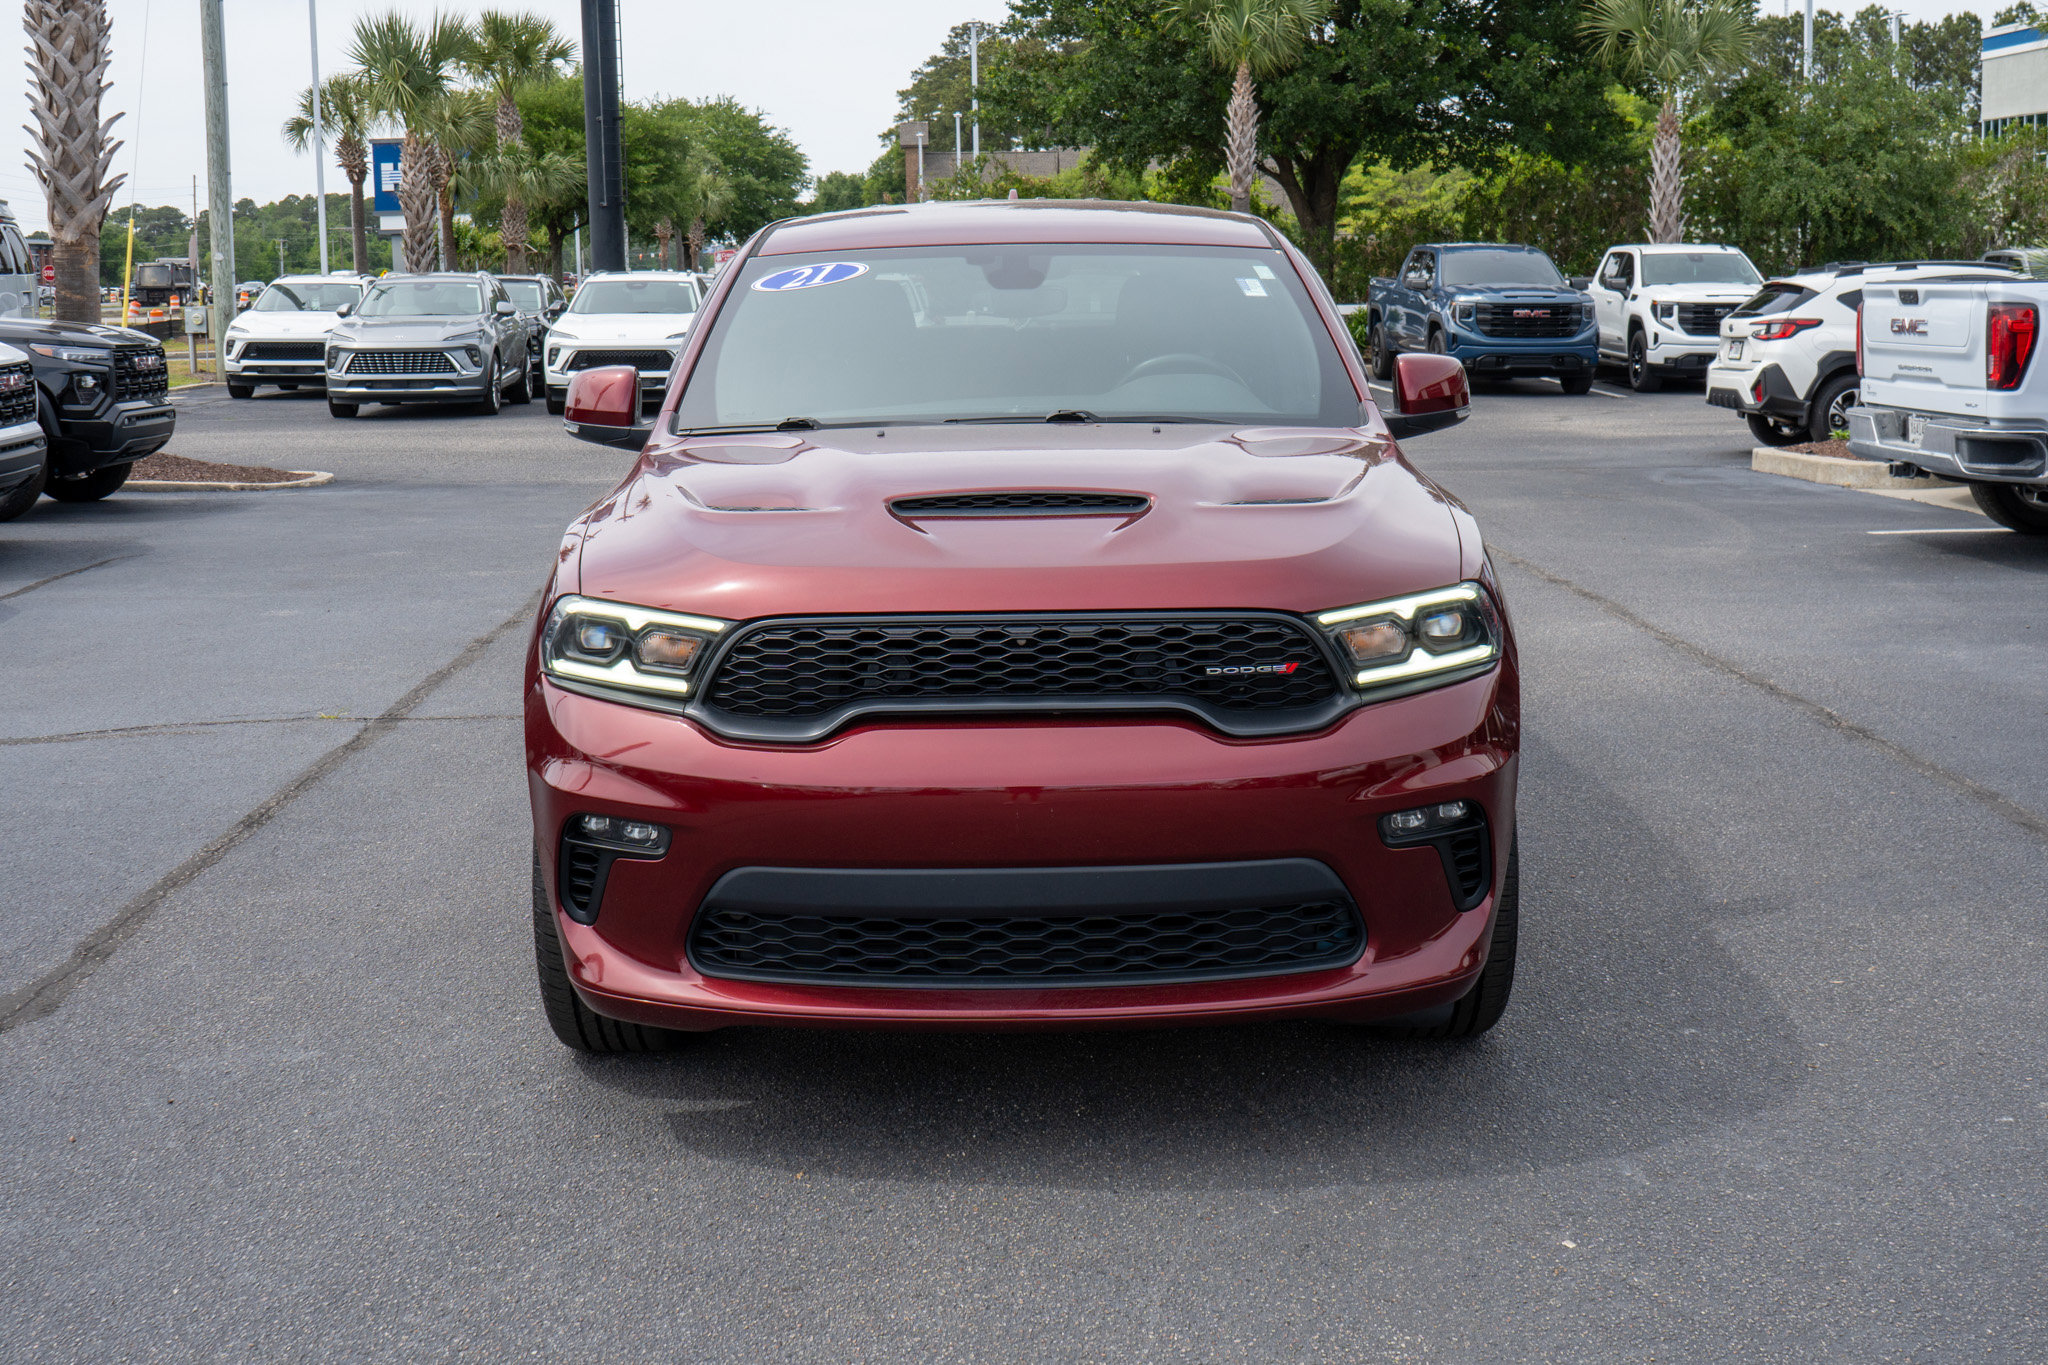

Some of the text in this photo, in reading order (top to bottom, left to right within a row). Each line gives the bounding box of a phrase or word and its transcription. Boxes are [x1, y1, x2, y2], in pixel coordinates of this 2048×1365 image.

[781, 264, 838, 289] 21
[1513, 309, 1551, 318] GMC
[1890, 318, 1928, 335] GMC
[1206, 665, 1287, 675] DODGE
